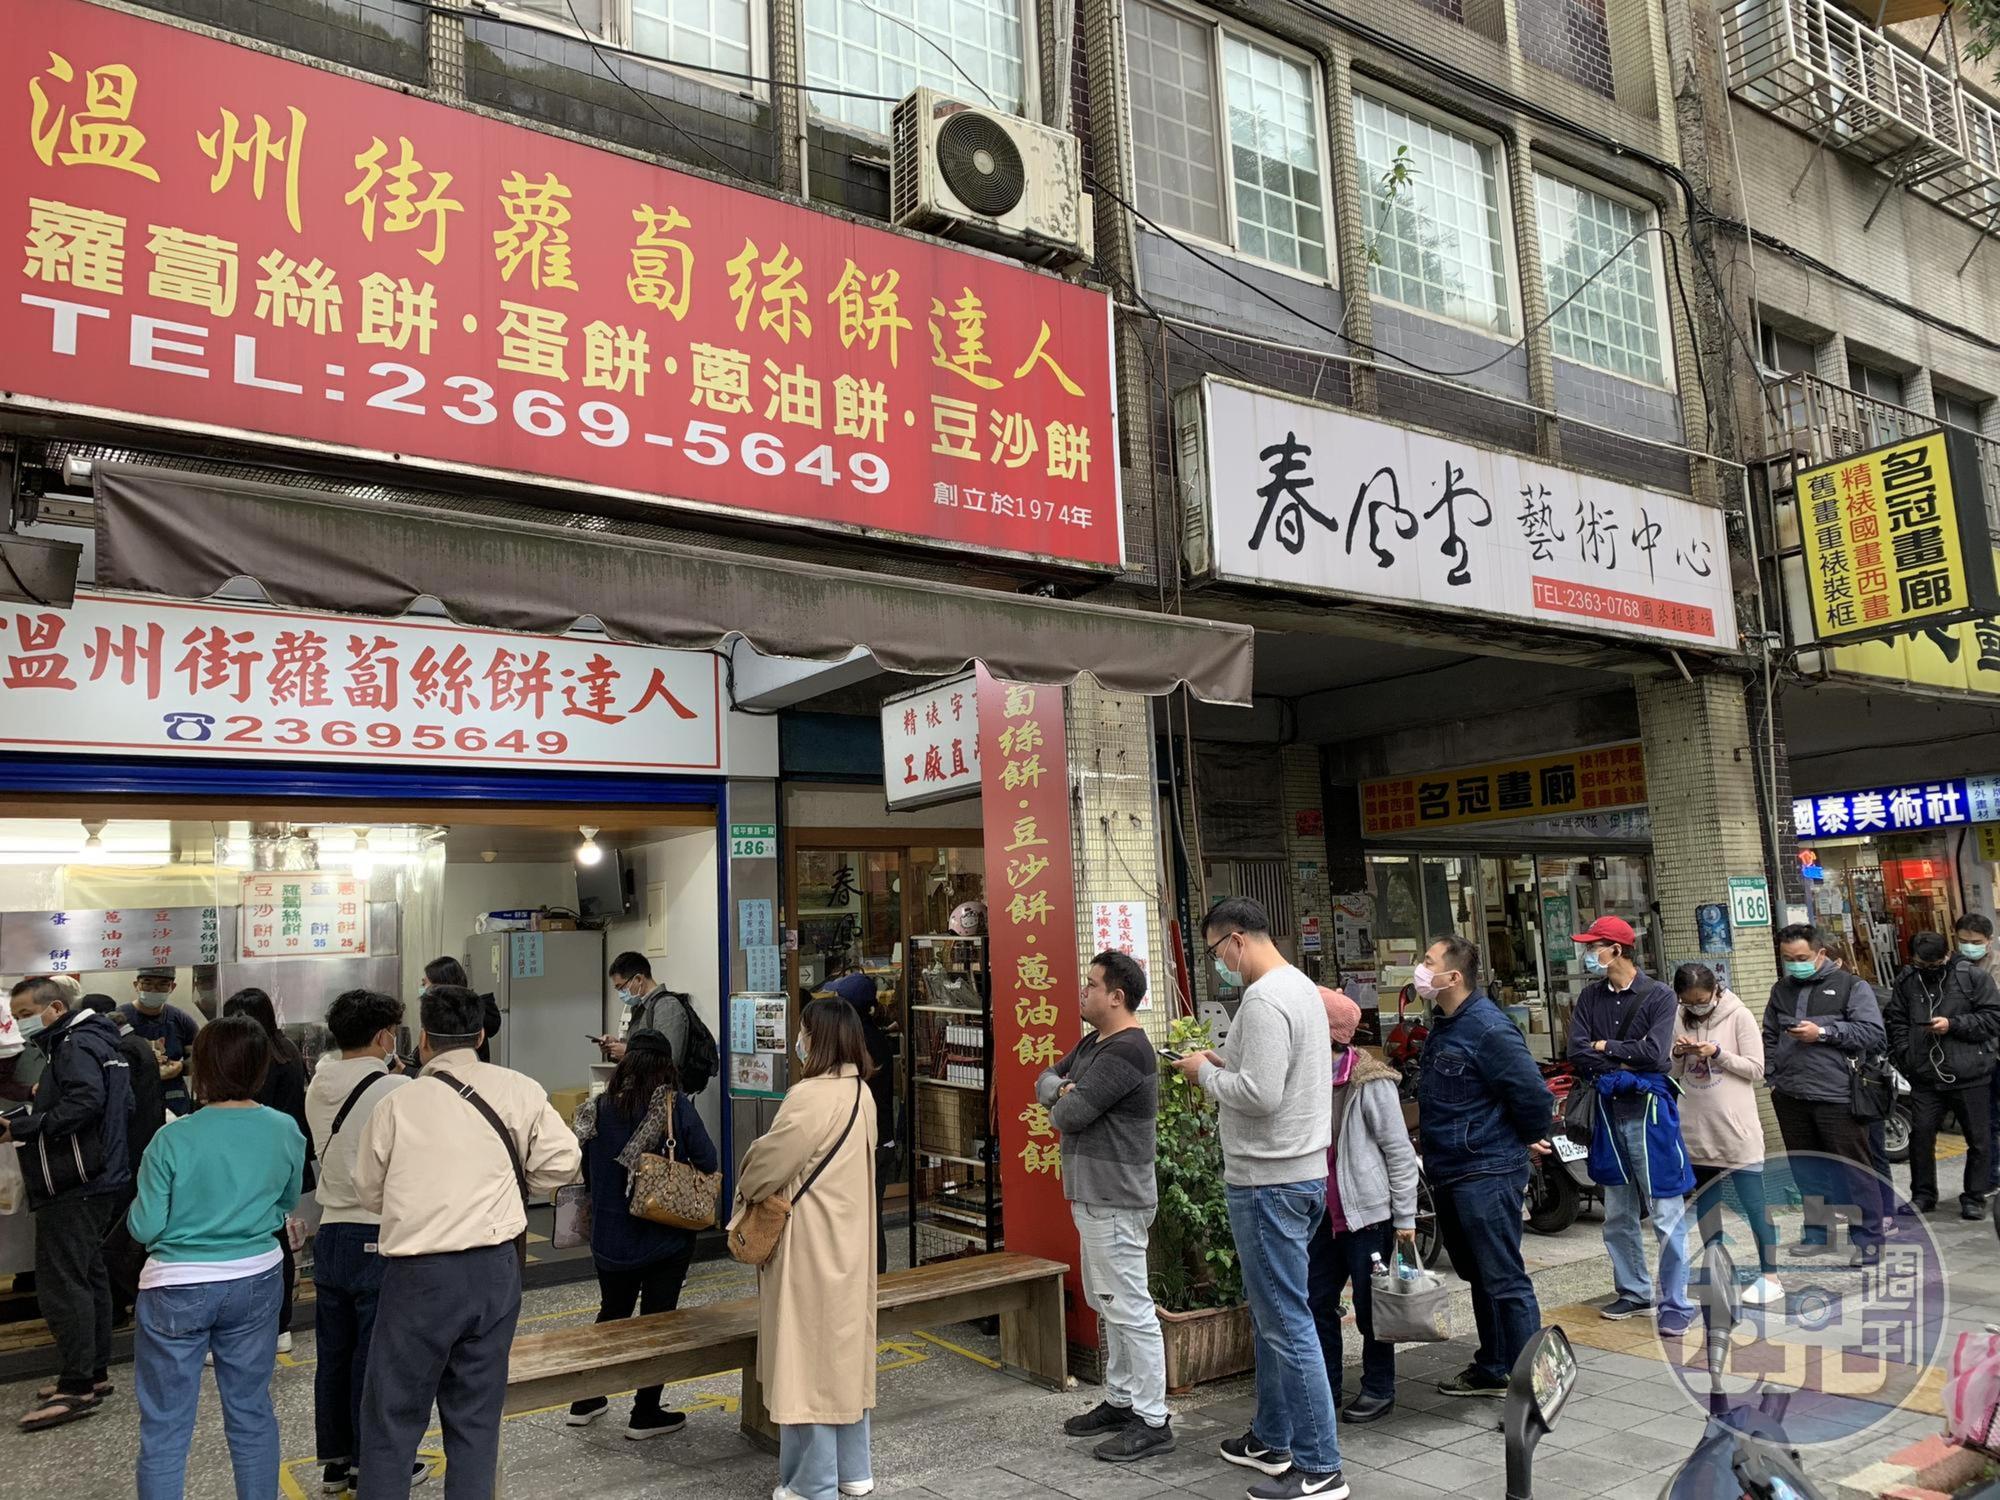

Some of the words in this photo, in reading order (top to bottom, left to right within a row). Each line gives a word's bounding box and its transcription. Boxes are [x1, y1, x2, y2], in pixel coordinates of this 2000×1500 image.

[28, 51, 1086, 397] 溫州街蘿蔔絲餅達人
[21, 293, 890, 495] TEL:2369-5649
[932, 481, 1093, 529] 創立於1974年
[1249, 431, 1493, 586] 春風堂
[1516, 483, 1712, 584] 藝術中心
[1807, 472, 1857, 629] 舊畫重裱裝框
[1842, 463, 1892, 622] 精裱國畫西畫
[1880, 446, 1952, 614] 名冠畫廊
[1534, 582, 1640, 619] TEL:2363-0768
[0, 612, 698, 725] 溫州街蘿蔔絲餅達人
[224, 715, 569, 755] 23695649
[903, 692, 980, 737] 精裱字
[903, 738, 981, 785] 工廠直
[1418, 764, 1577, 821] 名冠畫廊
[1793, 782, 1965, 836] 國泰美術社
[733, 840, 764, 855] 186
[253, 882, 273, 937] 豆沙餅
[282, 884, 302, 936] 蘿蔔絲餅
[310, 882, 329, 936] 蛋餅
[1737, 896, 1765, 919] 186
[49, 912, 71, 960] 蛋餅
[101, 911, 122, 958] 蔥油餅
[152, 911, 172, 956] 豆沙餅
[257, 939, 270, 949] 30
[286, 938, 298, 947] 30
[313, 938, 326, 948] 35
[341, 938, 353, 947] 25
[52, 961, 68, 971] 35
[104, 959, 119, 969] 25
[155, 956, 168, 966] 30
[203, 953, 216, 963] 30
